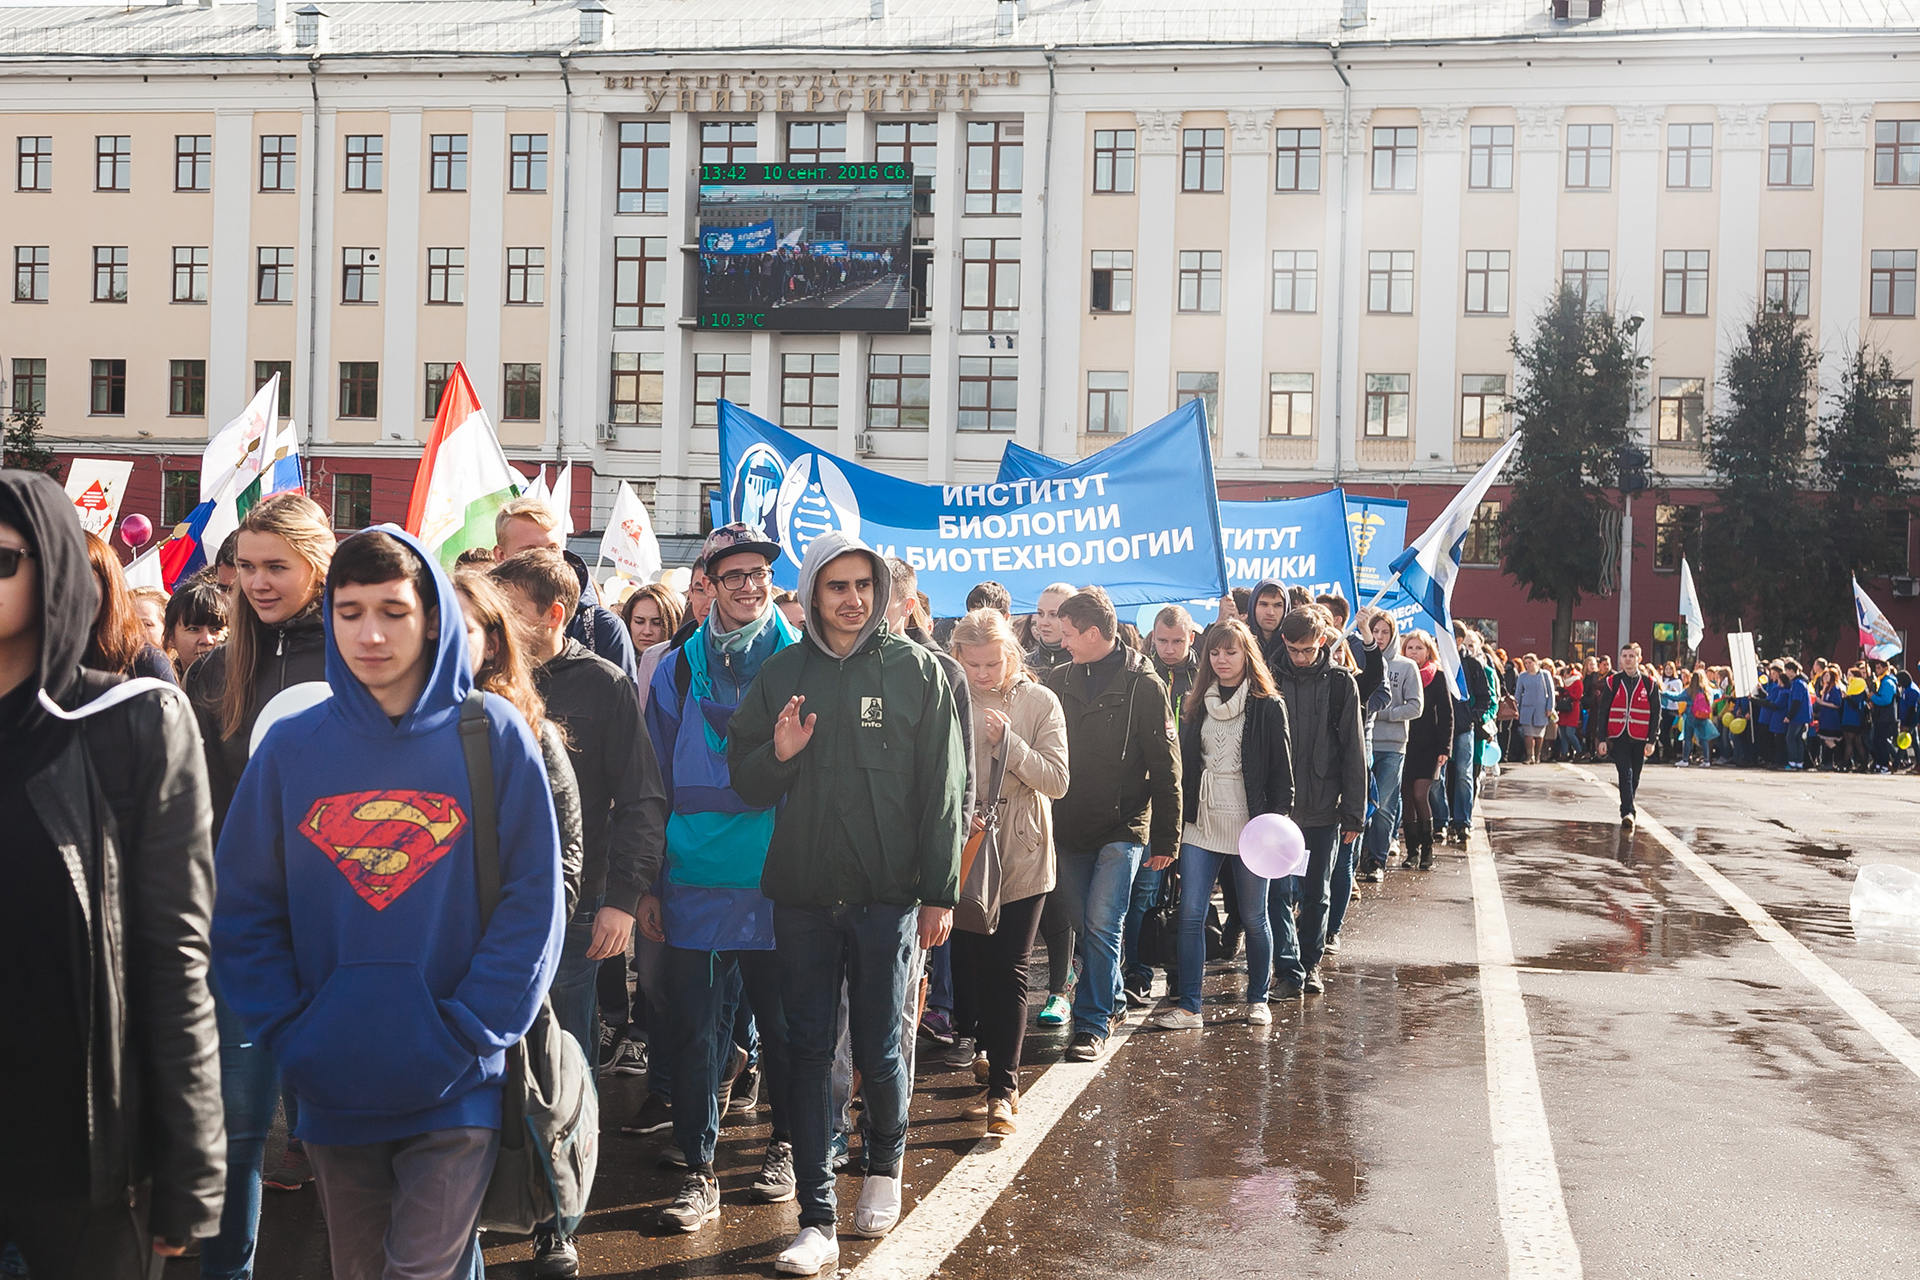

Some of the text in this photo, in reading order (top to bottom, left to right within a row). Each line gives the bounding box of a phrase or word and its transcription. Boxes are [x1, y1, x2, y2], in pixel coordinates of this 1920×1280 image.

[603, 70, 1020, 90] ВЯТСКИЙ ГОСУДАРСТВЕННЫЙ
[644, 88, 978, 113] УНИВЕРСИТЕТ
[702, 165, 910, 180] 13:42 10 сент. 2016 Сб.
[941, 472, 1109, 507] ИНСТИТУТ
[938, 503, 1122, 540] БИОЛОГИИ
[906, 526, 1195, 572] БИОТЕХНОЛОГИИ
